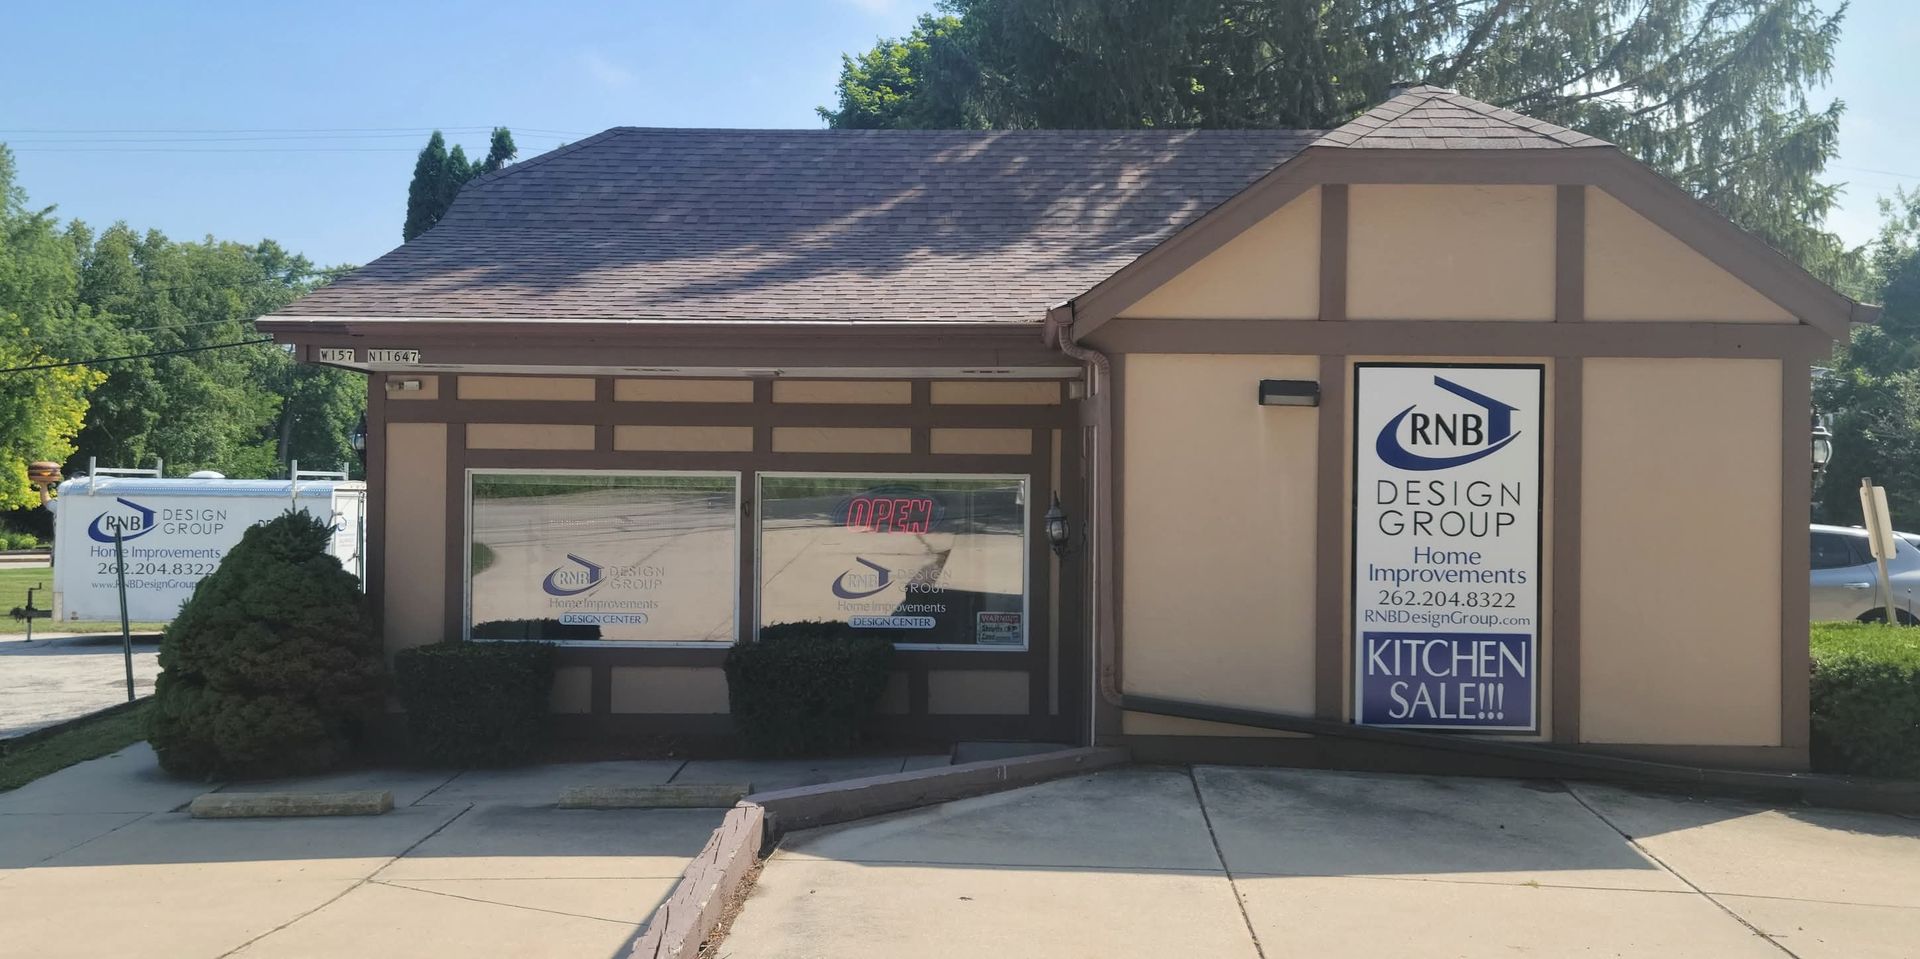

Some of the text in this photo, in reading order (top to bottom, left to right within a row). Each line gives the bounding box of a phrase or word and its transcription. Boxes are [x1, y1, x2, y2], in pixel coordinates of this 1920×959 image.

[321, 350, 417, 362] W157 N11647
[1410, 412, 1484, 447] RNB
[1377, 479, 1521, 508] DESIGN
[163, 508, 227, 521] DESIGN
[847, 495, 933, 535] OPEN
[105, 515, 141, 531] RNB
[164, 522, 225, 535] GROUP
[1378, 509, 1516, 538] GROUP
[131, 545, 221, 561] Improvements
[1413, 546, 1482, 565] Home
[97, 562, 215, 576] 262.204.8322
[609, 565, 665, 578] DESIGN
[896, 568, 952, 580] DESIGN
[1369, 563, 1527, 588] Improvements
[559, 571, 590, 586] RNB
[610, 579, 663, 591] GROUP
[848, 573, 879, 588] RNB
[897, 582, 949, 594] GROUP
[550, 597, 659, 612] Home Improvements
[1378, 589, 1516, 608] 262.204.8322
[837, 600, 946, 615] Home Improvements
[563, 614, 642, 625] DESIGN CENTER
[852, 617, 932, 628] DESIGN CENTER
[1364, 609, 1531, 628] RNBDesignGroup.com
[1368, 638, 1526, 679] KITCHEN
[1388, 680, 1505, 721] SALE!!!
